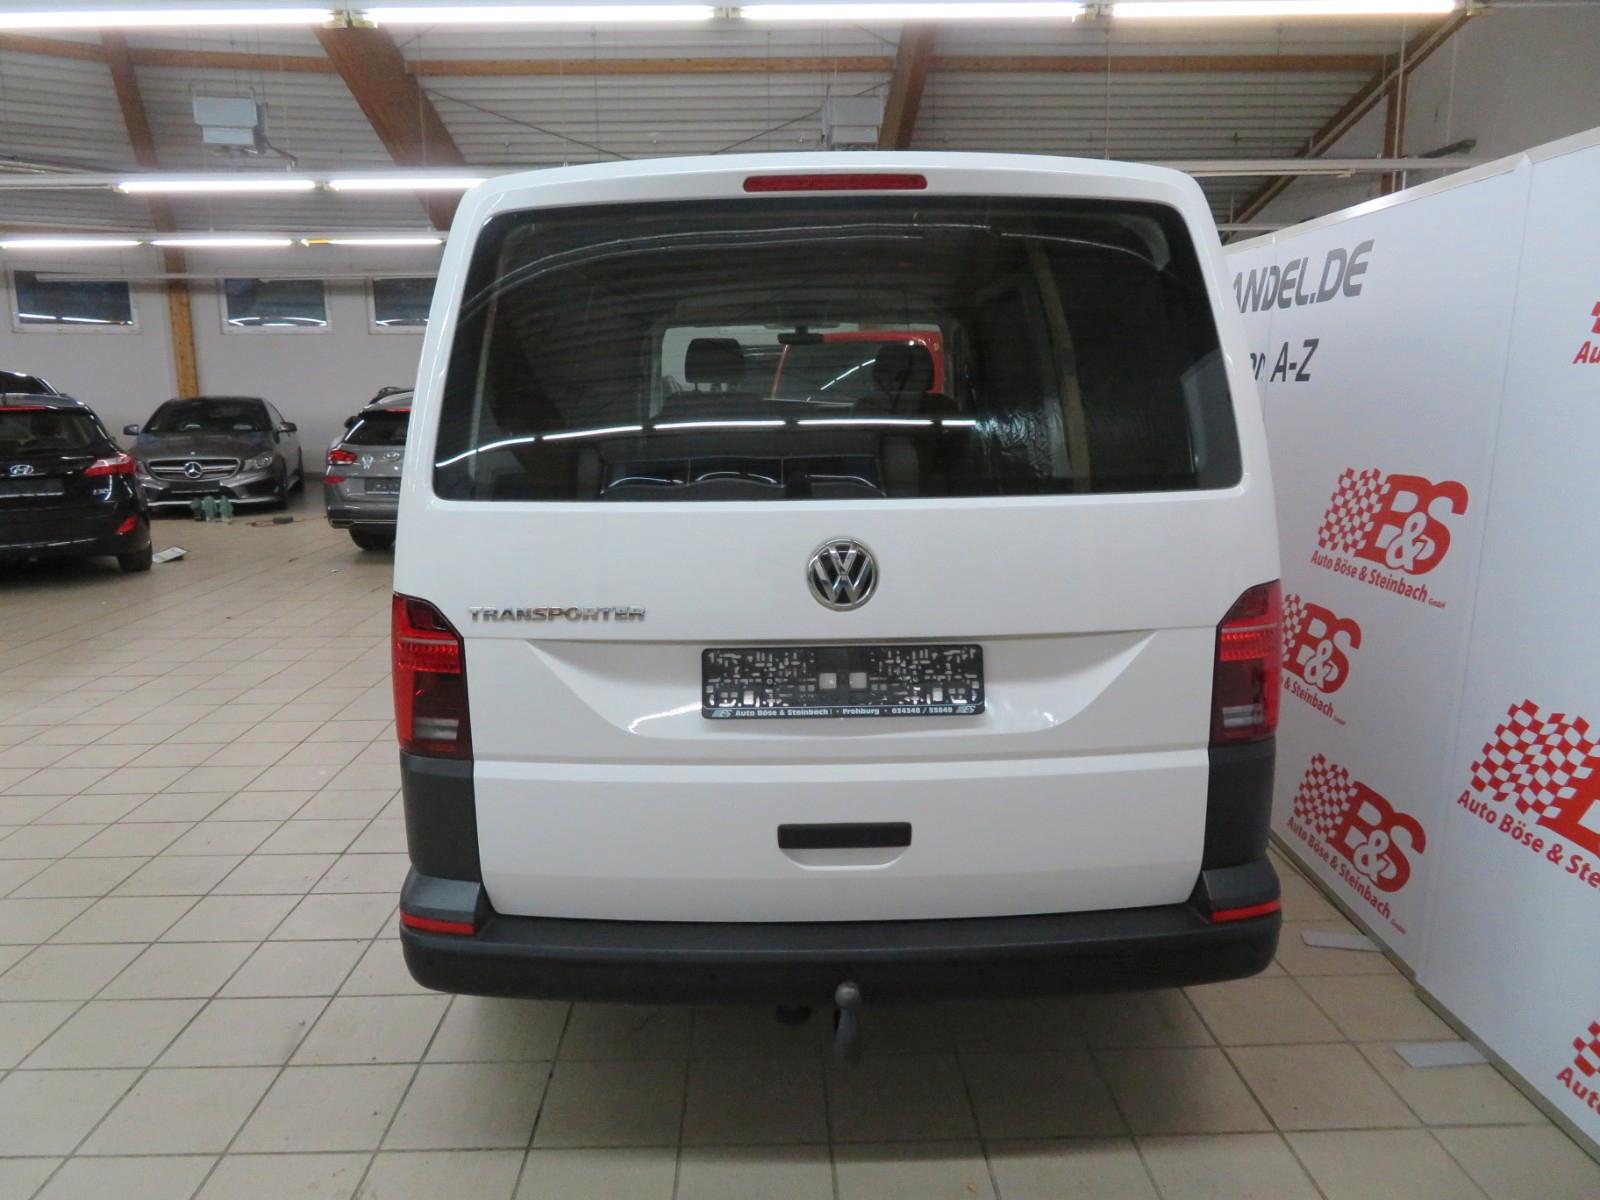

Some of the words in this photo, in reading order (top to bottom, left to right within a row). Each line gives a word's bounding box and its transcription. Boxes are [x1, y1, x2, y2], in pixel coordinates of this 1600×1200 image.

[1269, 338, 1320, 383] A-Z
[1354, 473, 1469, 576] B&S
[1310, 550, 1333, 571] Auto
[1333, 557, 1358, 578] Böse
[1358, 566, 1369, 582] &
[1368, 568, 1429, 603] Steinbach
[470, 606, 646, 623] TRANSPORTER
[1282, 602, 1362, 693] B&S
[735, 709, 756, 717] Auto
[787, 707, 829, 716] Steinbach
[842, 708, 880, 716] Frohburg
[1291, 681, 1334, 718] Steinbach
[1326, 780, 1426, 893] B&S
[1457, 789, 1498, 824] Auto
[1497, 812, 1545, 853] Böse
[1546, 843, 1564, 865] &
[1288, 816, 1308, 842] Auto
[1308, 834, 1330, 862] Böse
[1329, 855, 1340, 871] &
[1338, 863, 1392, 919] Steinbach
